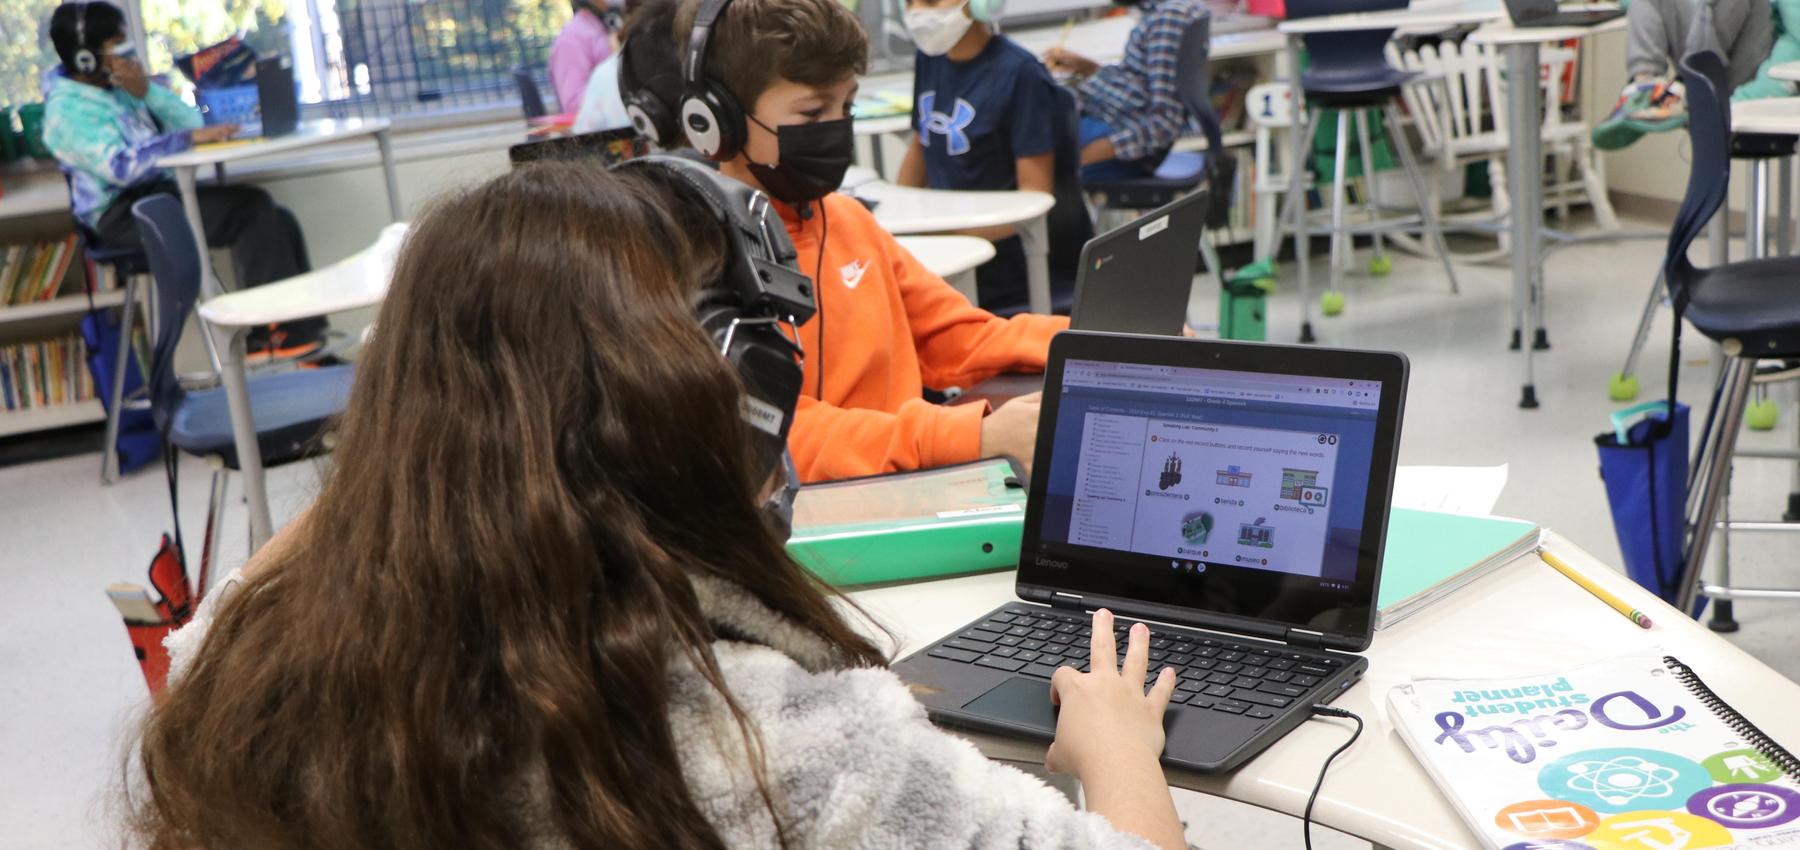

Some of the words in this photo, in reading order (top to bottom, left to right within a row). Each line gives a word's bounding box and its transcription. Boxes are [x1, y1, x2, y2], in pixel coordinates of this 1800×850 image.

[1279, 504, 1307, 514] biblioteca
[1035, 556, 1069, 569] Lenovo
[1451, 677, 1574, 703] planner
[1464, 693, 1590, 718] student
[1434, 691, 1686, 764] Daily
[1657, 721, 1697, 735] The
